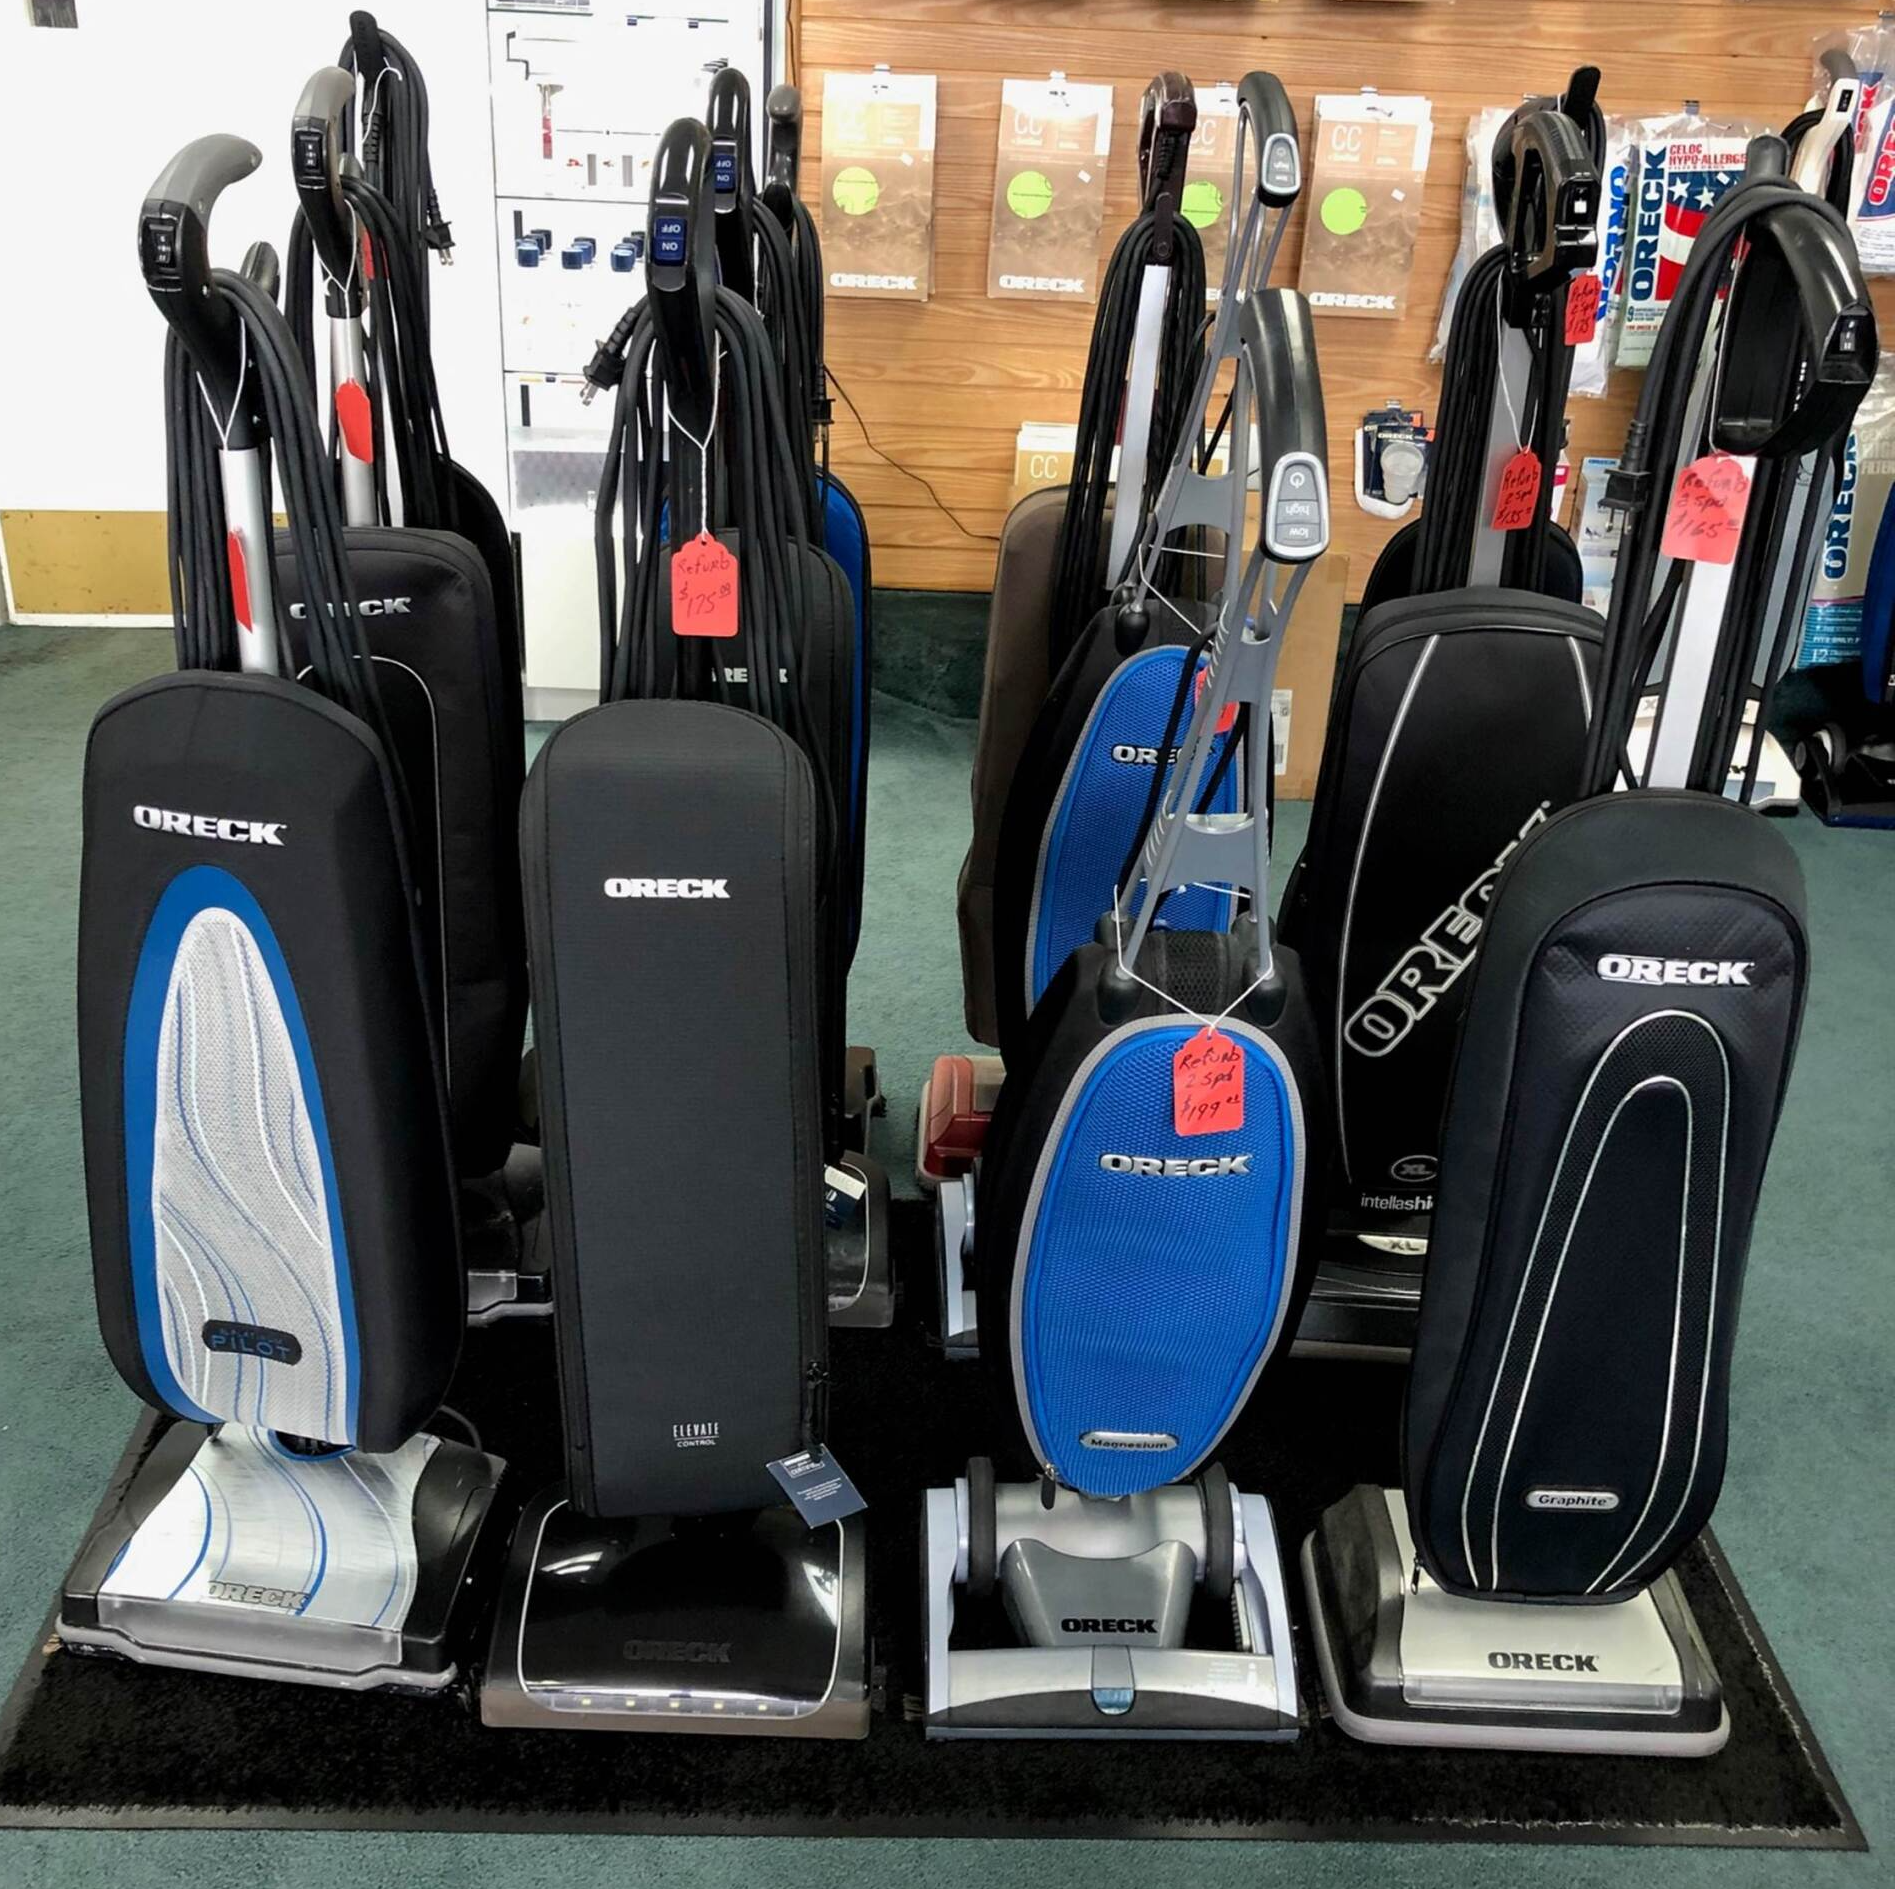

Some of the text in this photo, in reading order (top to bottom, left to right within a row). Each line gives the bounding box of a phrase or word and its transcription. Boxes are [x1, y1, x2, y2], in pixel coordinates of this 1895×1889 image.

[1331, 124, 1362, 153] CC
[714, 160, 731, 168] OFF
[661, 224, 681, 233] OFF
[1632, 146, 1667, 301] ORECK
[662, 242, 679, 251] ON
[830, 273, 917, 291] ORECK
[999, 275, 1085, 293] ORECK
[1309, 292, 1396, 310] ORECK
[1627, 306, 1634, 322] 9
[1378, 432, 1413, 440] ORECK
[1030, 454, 1059, 479] CC
[1286, 502, 1310, 516] high
[1289, 527, 1309, 538] low
[678, 550, 730, 575] Refurb
[289, 597, 411, 619] OCK
[1812, 649, 1829, 662] 12
[711, 667, 788, 683] REK
[1112, 744, 1183, 764] ORE
[133, 805, 286, 846] ORECK
[603, 877, 730, 900] ORECK
[1597, 955, 1752, 987] ORECK
[1179, 1045, 1241, 1070] Refurb
[1185, 1073, 1196, 1088] 2
[1100, 1153, 1249, 1177] ORECK
[207, 1332, 290, 1361] PILOT
[673, 1421, 720, 1438] ELEVATE
[676, 1439, 716, 1448] CONTROL
[1090, 1438, 1168, 1450] Magnesium
[1538, 1493, 1607, 1507] Graphite
[207, 1580, 312, 1613] ORECK
[1060, 1618, 1158, 1634] ORECK
[622, 1640, 733, 1663] ORECK
[1487, 1651, 1600, 1673] ORECK
